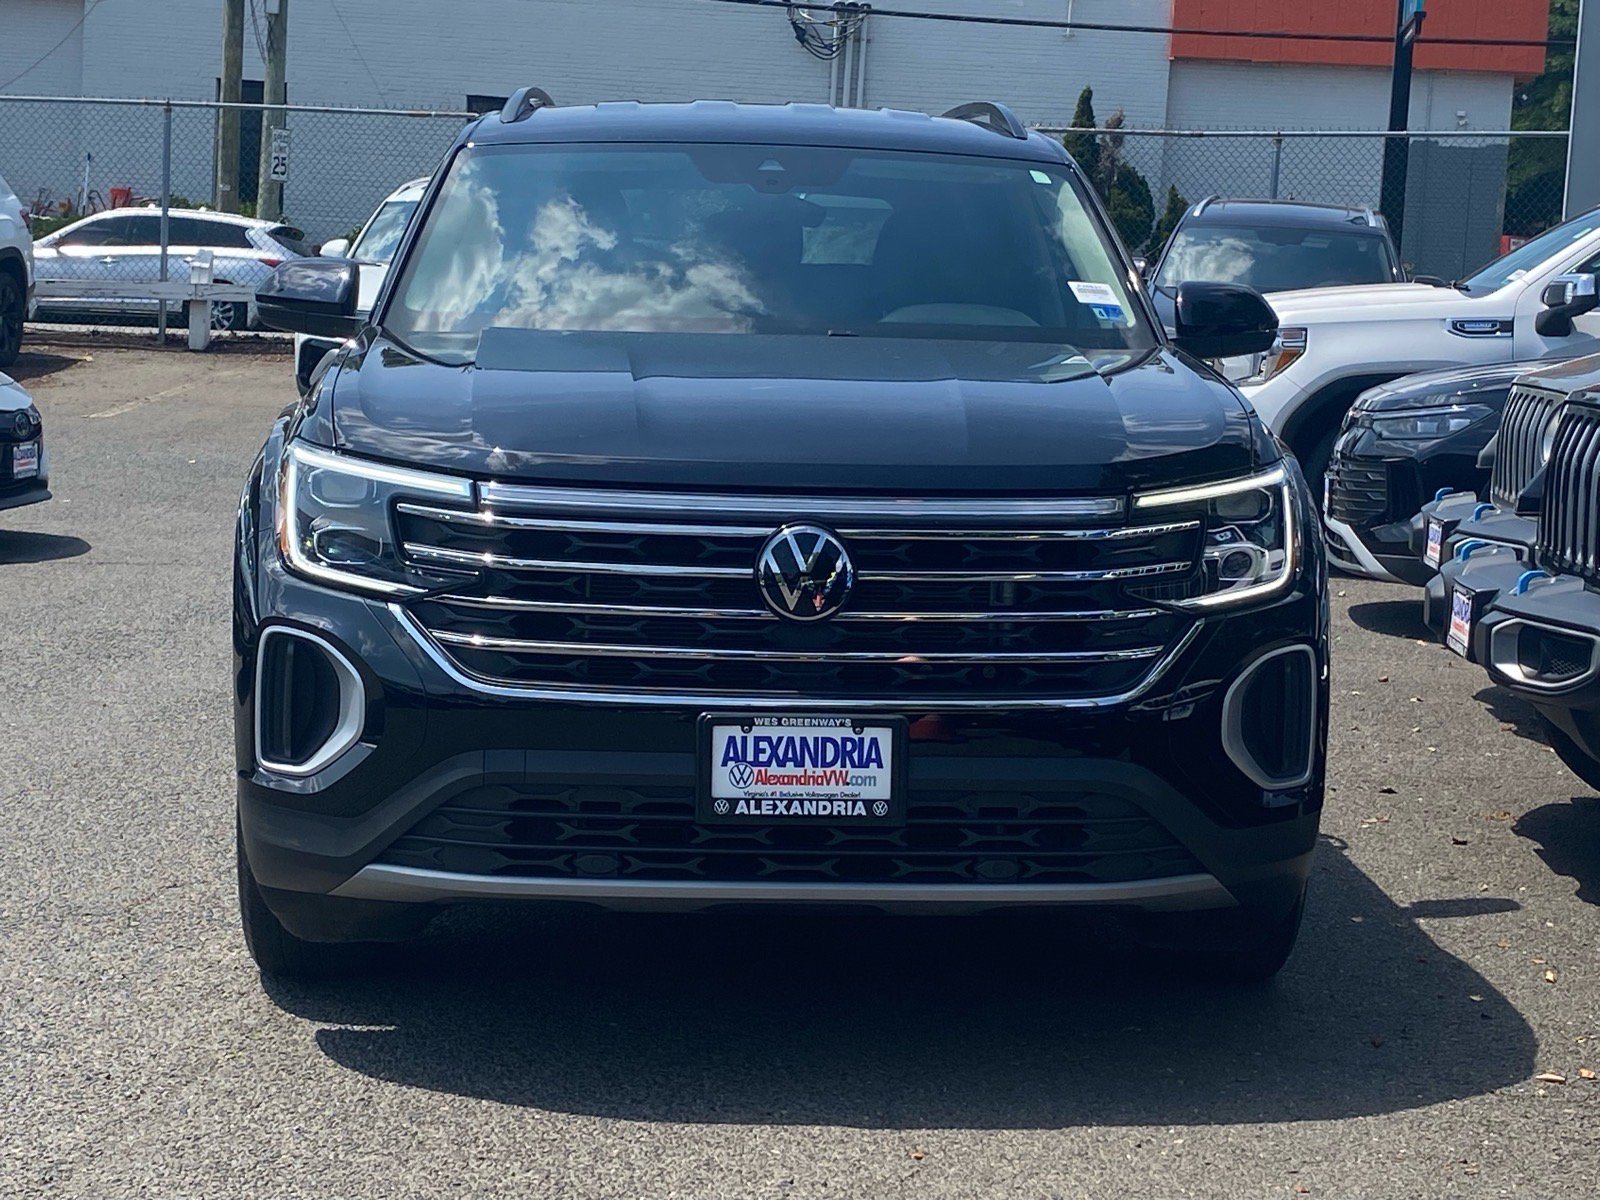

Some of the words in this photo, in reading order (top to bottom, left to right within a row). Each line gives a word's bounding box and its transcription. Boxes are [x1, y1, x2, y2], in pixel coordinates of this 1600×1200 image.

[272, 156, 287, 175] 25
[754, 717, 778, 726] WES
[781, 718, 852, 727] GREENWAY'S
[721, 735, 884, 769] ALEXANDRIA
[754, 769, 877, 788] AlexandriaVW.com
[805, 791, 839, 800] Volkswagen
[734, 800, 867, 816] ALEXANDRIA
